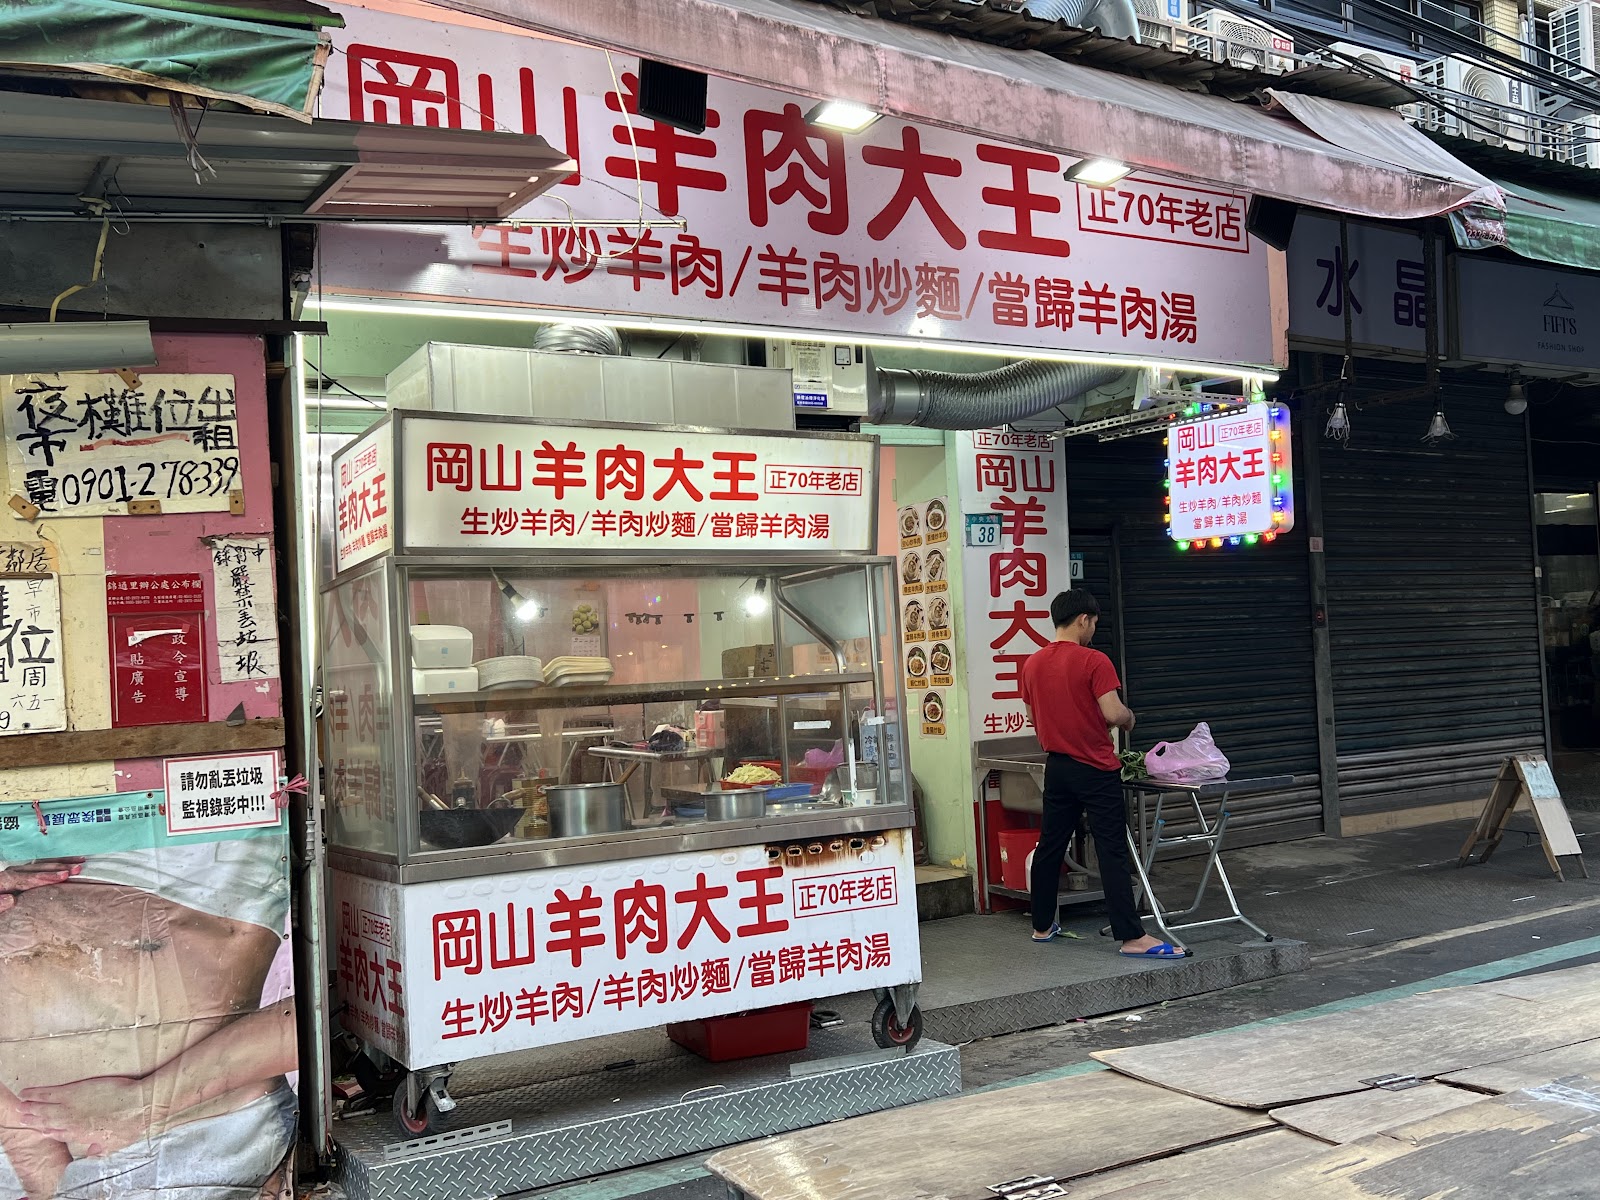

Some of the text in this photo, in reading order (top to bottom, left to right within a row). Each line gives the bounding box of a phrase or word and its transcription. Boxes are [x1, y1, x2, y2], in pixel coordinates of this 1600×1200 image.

[1087, 184, 1244, 243] 正70年老店
[1537, 341, 1566, 352] FASHION
[977, 433, 1050, 449] 正70年老店
[1177, 423, 1215, 453] 岡山
[1221, 424, 1262, 438] 正70年老店
[427, 440, 759, 502] 岡山羊肉大王
[769, 470, 859, 492] 正70年老店
[975, 454, 1055, 493] 岡山
[1175, 447, 1265, 489] 羊肉大王
[339, 472, 388, 540] 羊肉大王
[1178, 491, 1262, 514] 生炒羊肉/羊肉炒麵
[1193, 511, 1248, 530] 當歸羊肉湯
[462, 506, 829, 539] 生炒羊肉/羊肉炒麵/當歸羊肉湯
[978, 526, 995, 543] 38
[988, 495, 1050, 700] 羊肉大王
[130, 643, 147, 704] 貼廣告
[171, 633, 190, 702] 政令宣導
[983, 712, 1036, 734] 生炒
[180, 766, 264, 792] 請勿亂丟垃圾
[181, 794, 266, 820] 監視錄影中!!!
[798, 875, 893, 911] 正70年老店
[341, 901, 360, 939] 岡山
[432, 866, 790, 981] 岡山羊肉大王
[339, 936, 405, 1018] 羊肉大王
[441, 932, 891, 1040] 生炒羊肉/羊肉炒麵/當歸羊肉湯
